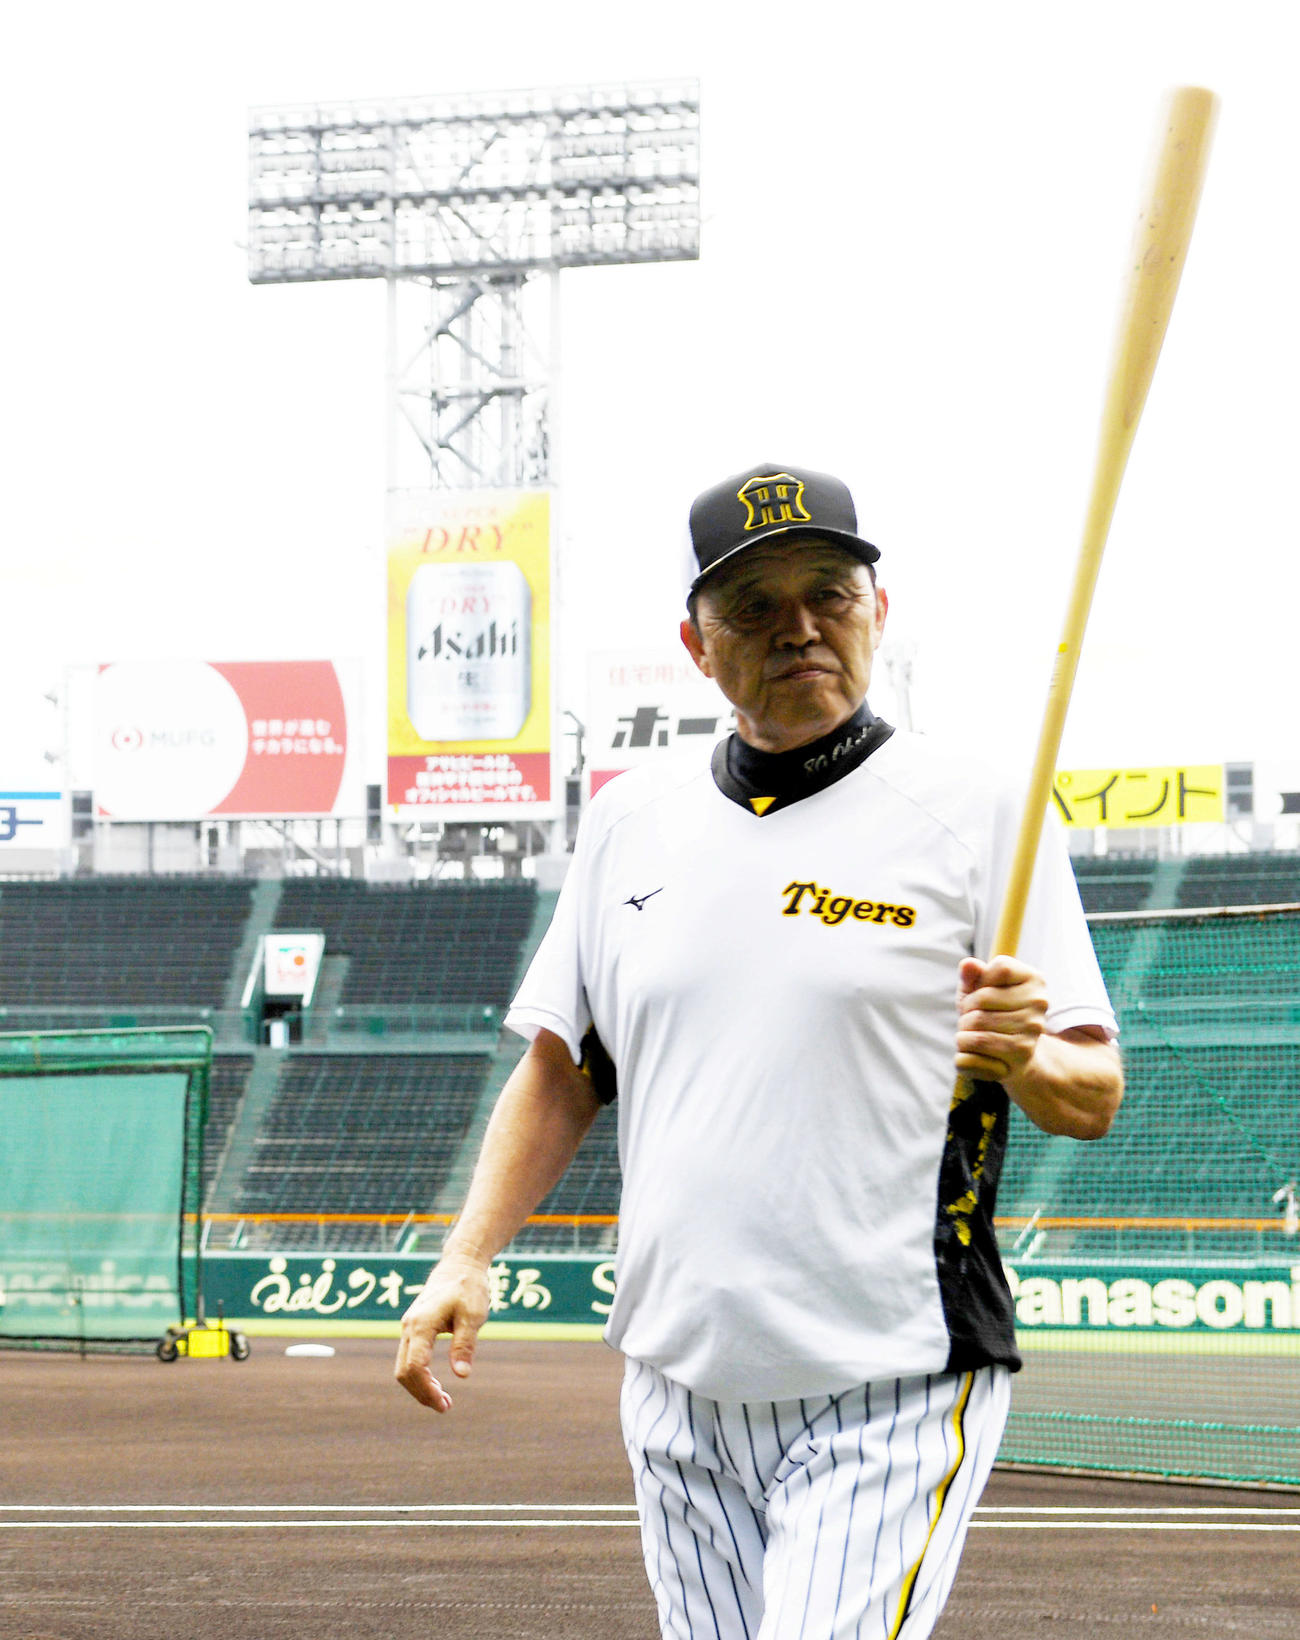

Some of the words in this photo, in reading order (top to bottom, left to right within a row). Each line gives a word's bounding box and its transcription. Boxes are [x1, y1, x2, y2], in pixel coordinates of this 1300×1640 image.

[420, 525, 504, 553] DRY
[417, 619, 517, 660] Asahi
[151, 730, 216, 747] MUFG
[611, 705, 737, 748] ホー
[782, 881, 916, 928] Tigers
